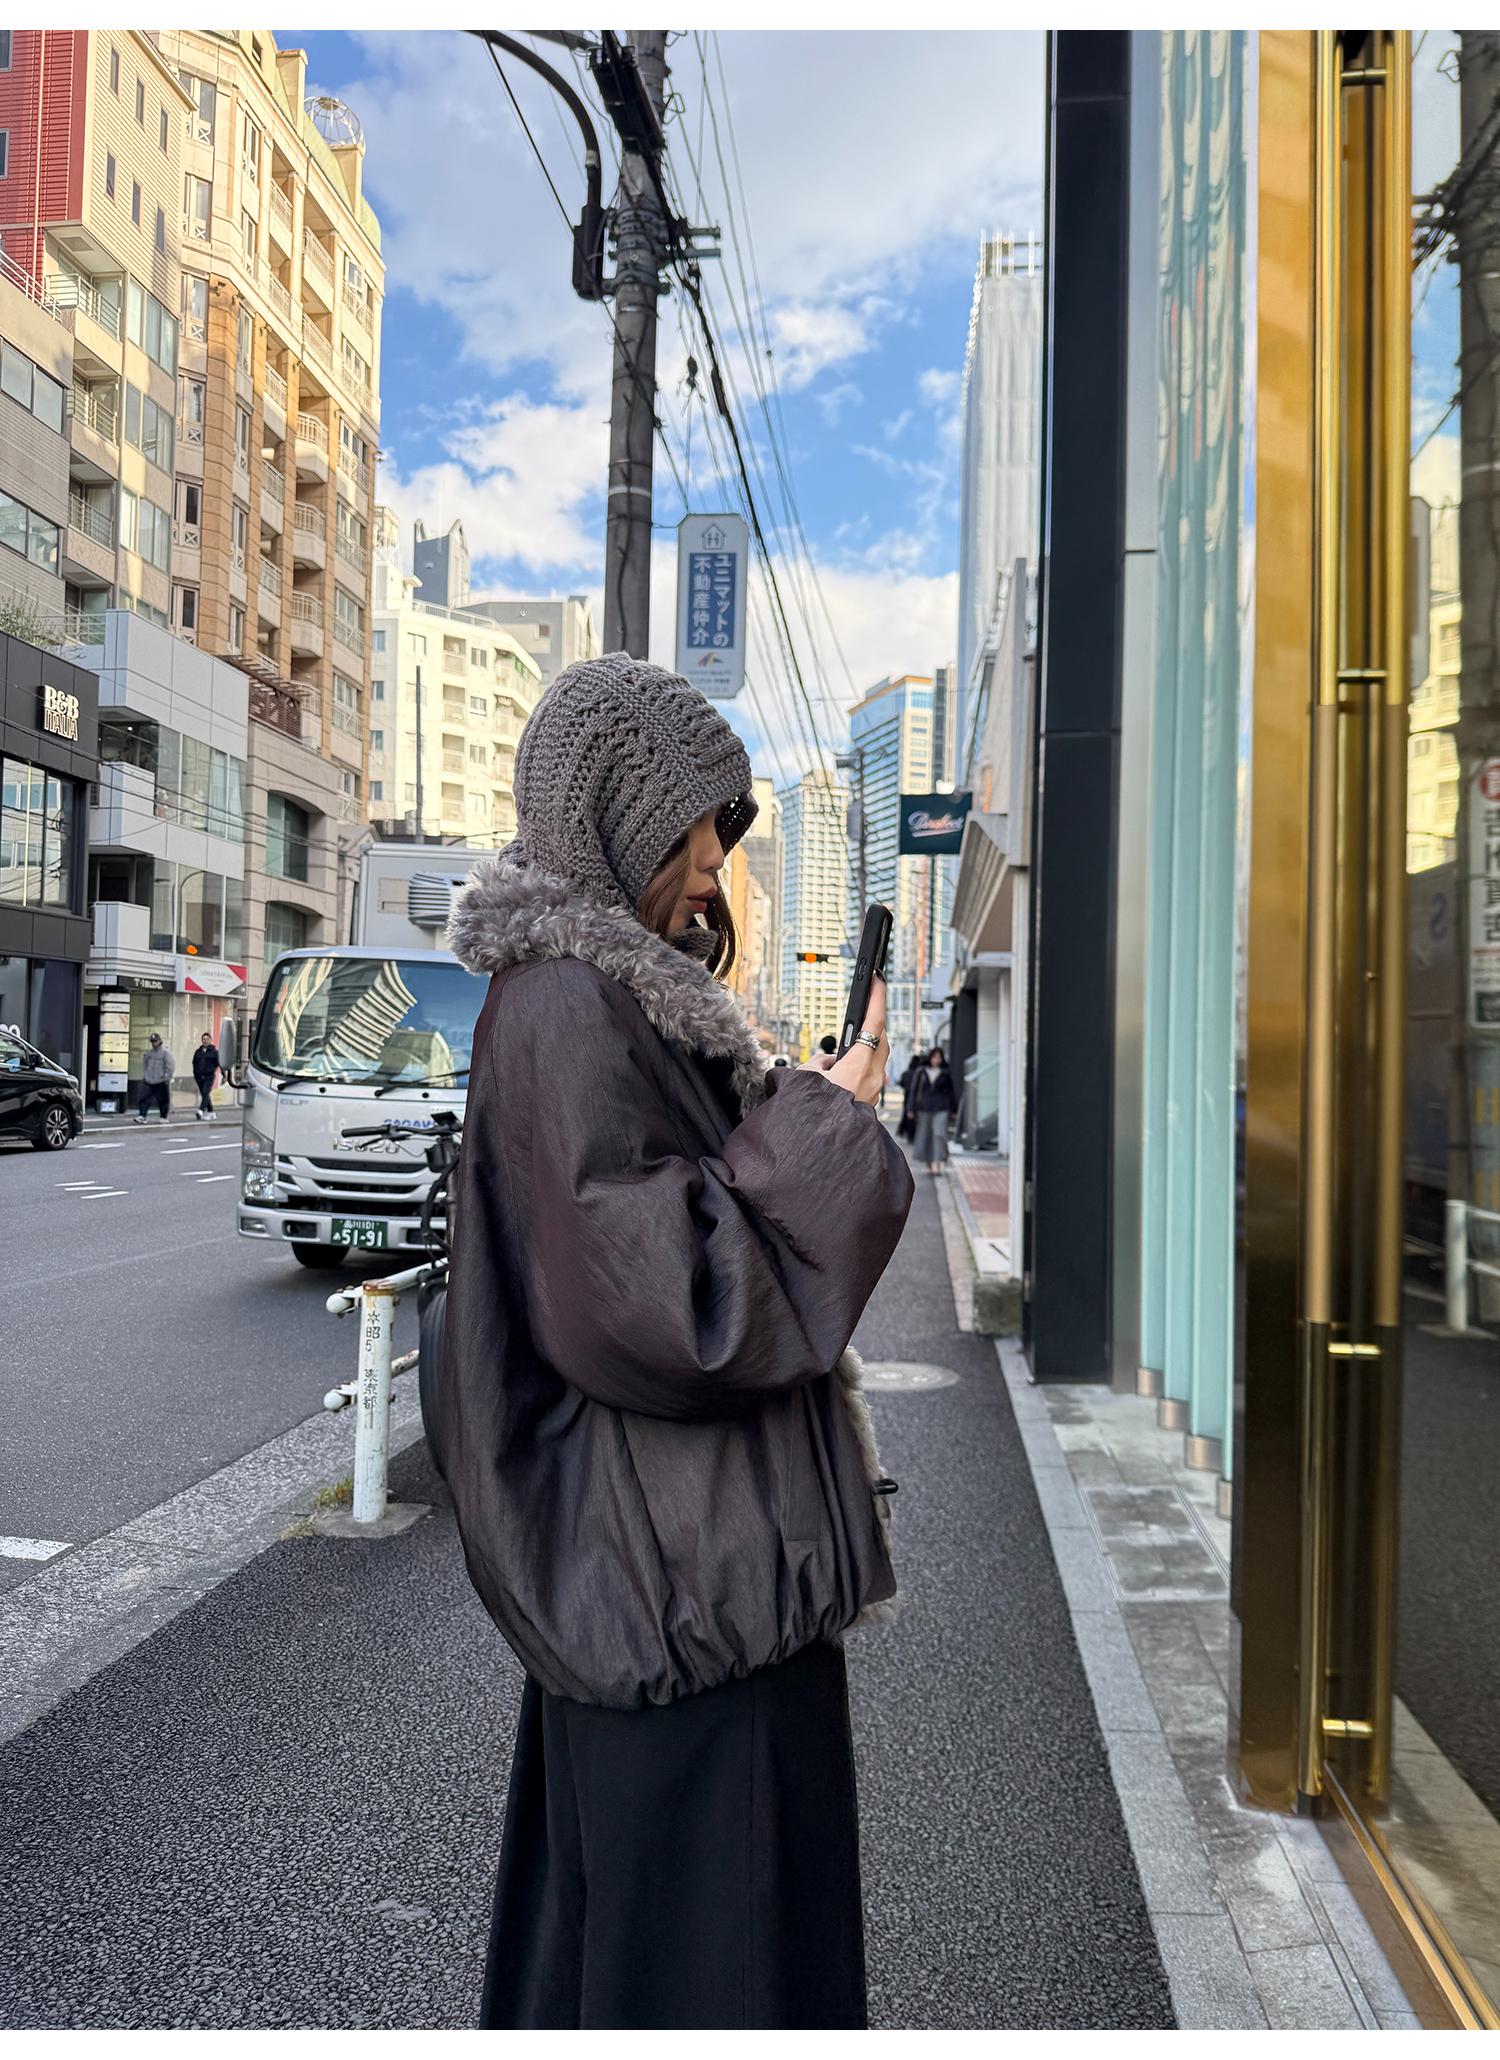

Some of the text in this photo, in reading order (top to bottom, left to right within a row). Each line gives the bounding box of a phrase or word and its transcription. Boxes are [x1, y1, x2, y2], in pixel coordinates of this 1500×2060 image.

[692, 555, 712, 646] 不動産仲介
[713, 555, 732, 647] ユニマットの
[44, 684, 79, 720] B&B
[44, 708, 78, 742] ITALIA
[341, 1228, 383, 1247] 51-91
